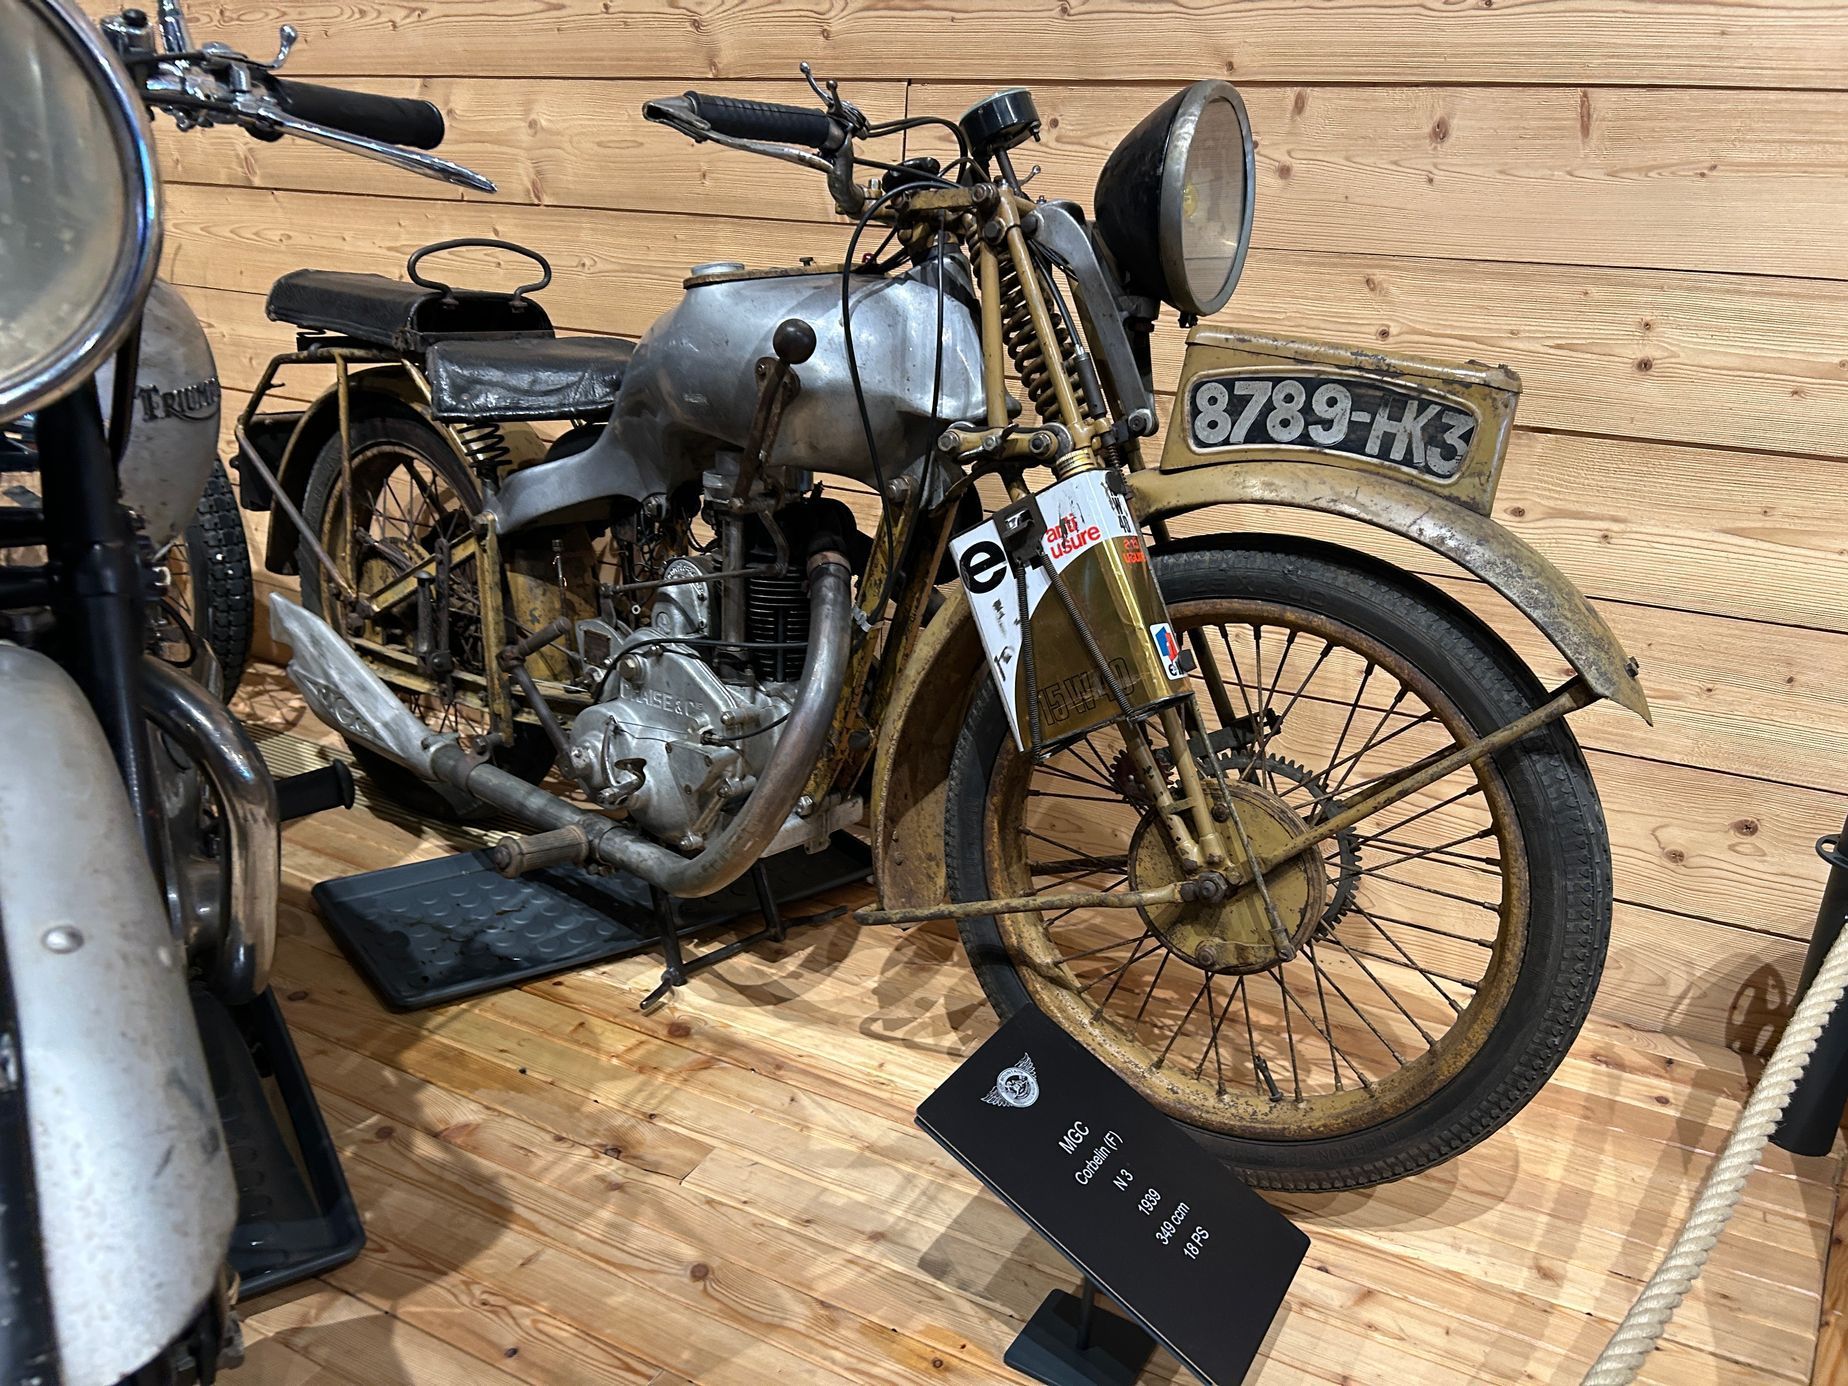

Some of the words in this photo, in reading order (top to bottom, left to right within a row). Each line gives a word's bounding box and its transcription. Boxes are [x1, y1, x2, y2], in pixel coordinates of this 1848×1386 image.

[1194, 379, 1476, 476] 8789-HK3
[1050, 526, 1101, 559] usure
[1058, 1121, 1090, 1155] MGC
[1075, 1145, 1111, 1185] Corbelin
[1103, 1130, 1124, 1151] (F)
[1112, 1175, 1128, 1191] N
[1120, 1168, 1134, 1182] 3
[1137, 1188, 1161, 1215] 1939
[1155, 1220, 1176, 1245] 349
[1171, 1202, 1190, 1226] ccm
[1190, 1226, 1210, 1247] PS
[1183, 1242, 1201, 1260] 18
